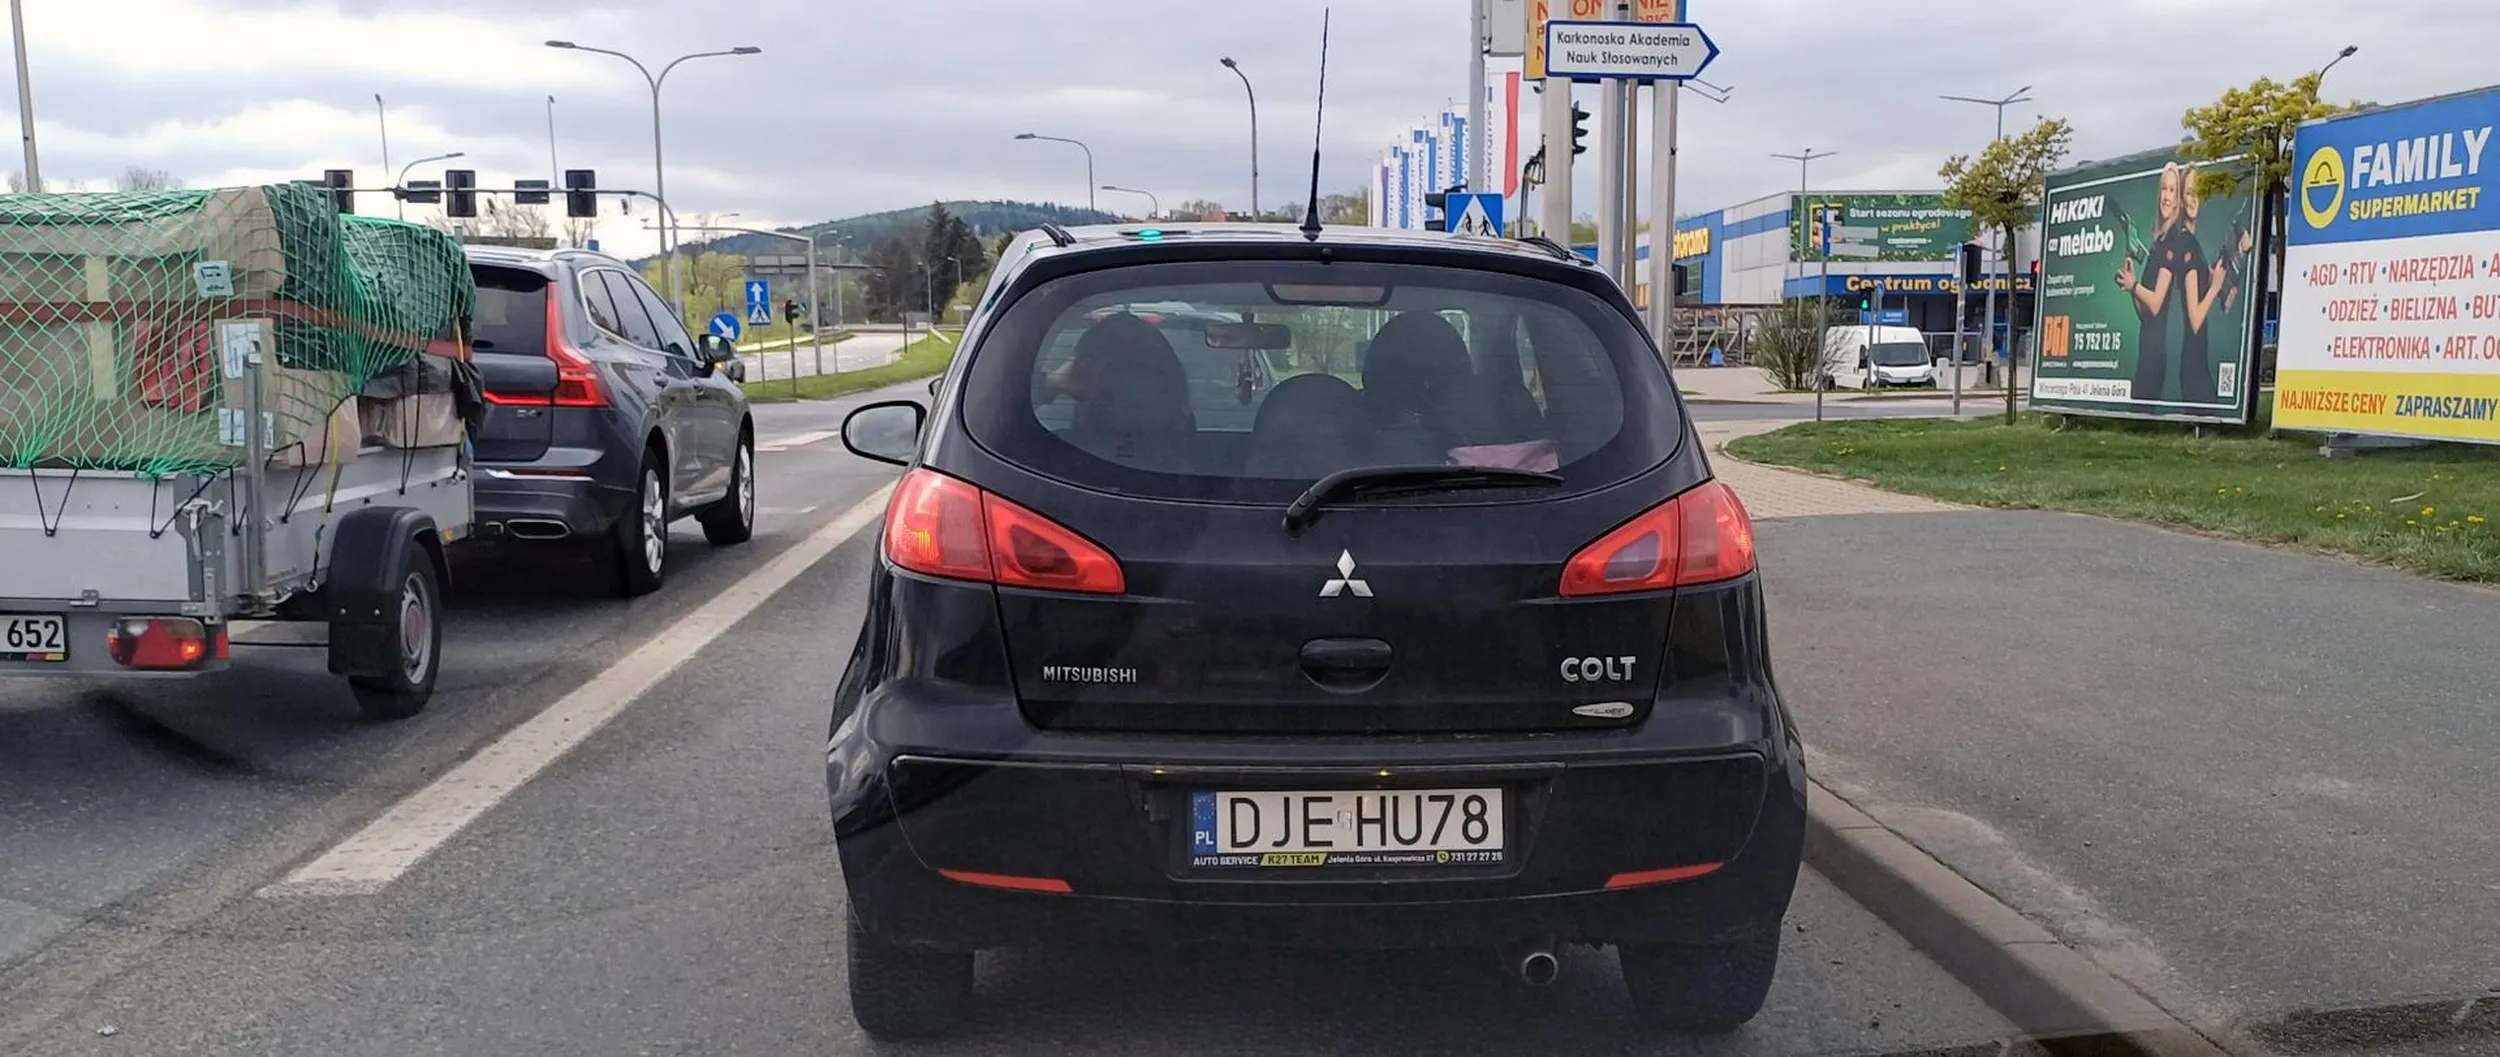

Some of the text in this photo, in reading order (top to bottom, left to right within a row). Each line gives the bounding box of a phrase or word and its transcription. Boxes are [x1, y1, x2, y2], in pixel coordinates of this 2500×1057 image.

[1557, 31, 1625, 45] Karkonoska
[1629, 33, 1691, 47] Akademia
[1566, 51, 1678, 68] Nauk Stosowanych
[2351, 126, 2492, 189] FAMILY
[1850, 208, 1874, 218] Start
[2050, 195, 2105, 224] HiKOKI
[2349, 186, 2481, 221] SUPERMARKET
[2308, 253, 2500, 287] AGD RTV NARZĘDZIA A
[2328, 293, 2379, 322] ODZIEŻ
[2390, 296, 2457, 321] BIELIZNA
[2333, 336, 2430, 359] ELEKTRONIKA
[2443, 335, 2479, 360] ART.
[2280, 386, 2499, 421] NAJNIŻSZE CENY ZAPRASZAMY
[7, 619, 61, 648] 652
[1043, 666, 1137, 683] MITSUBISHI
[1560, 656, 1636, 682] COLT
[1230, 794, 1489, 848] DJE HU78
[1195, 831, 1214, 845] PL
[1193, 857, 1219, 866] AUTO
[1220, 856, 1259, 865] SERVICE
[1268, 855, 1288, 864] K27
[1289, 854, 1320, 864] TEAM
